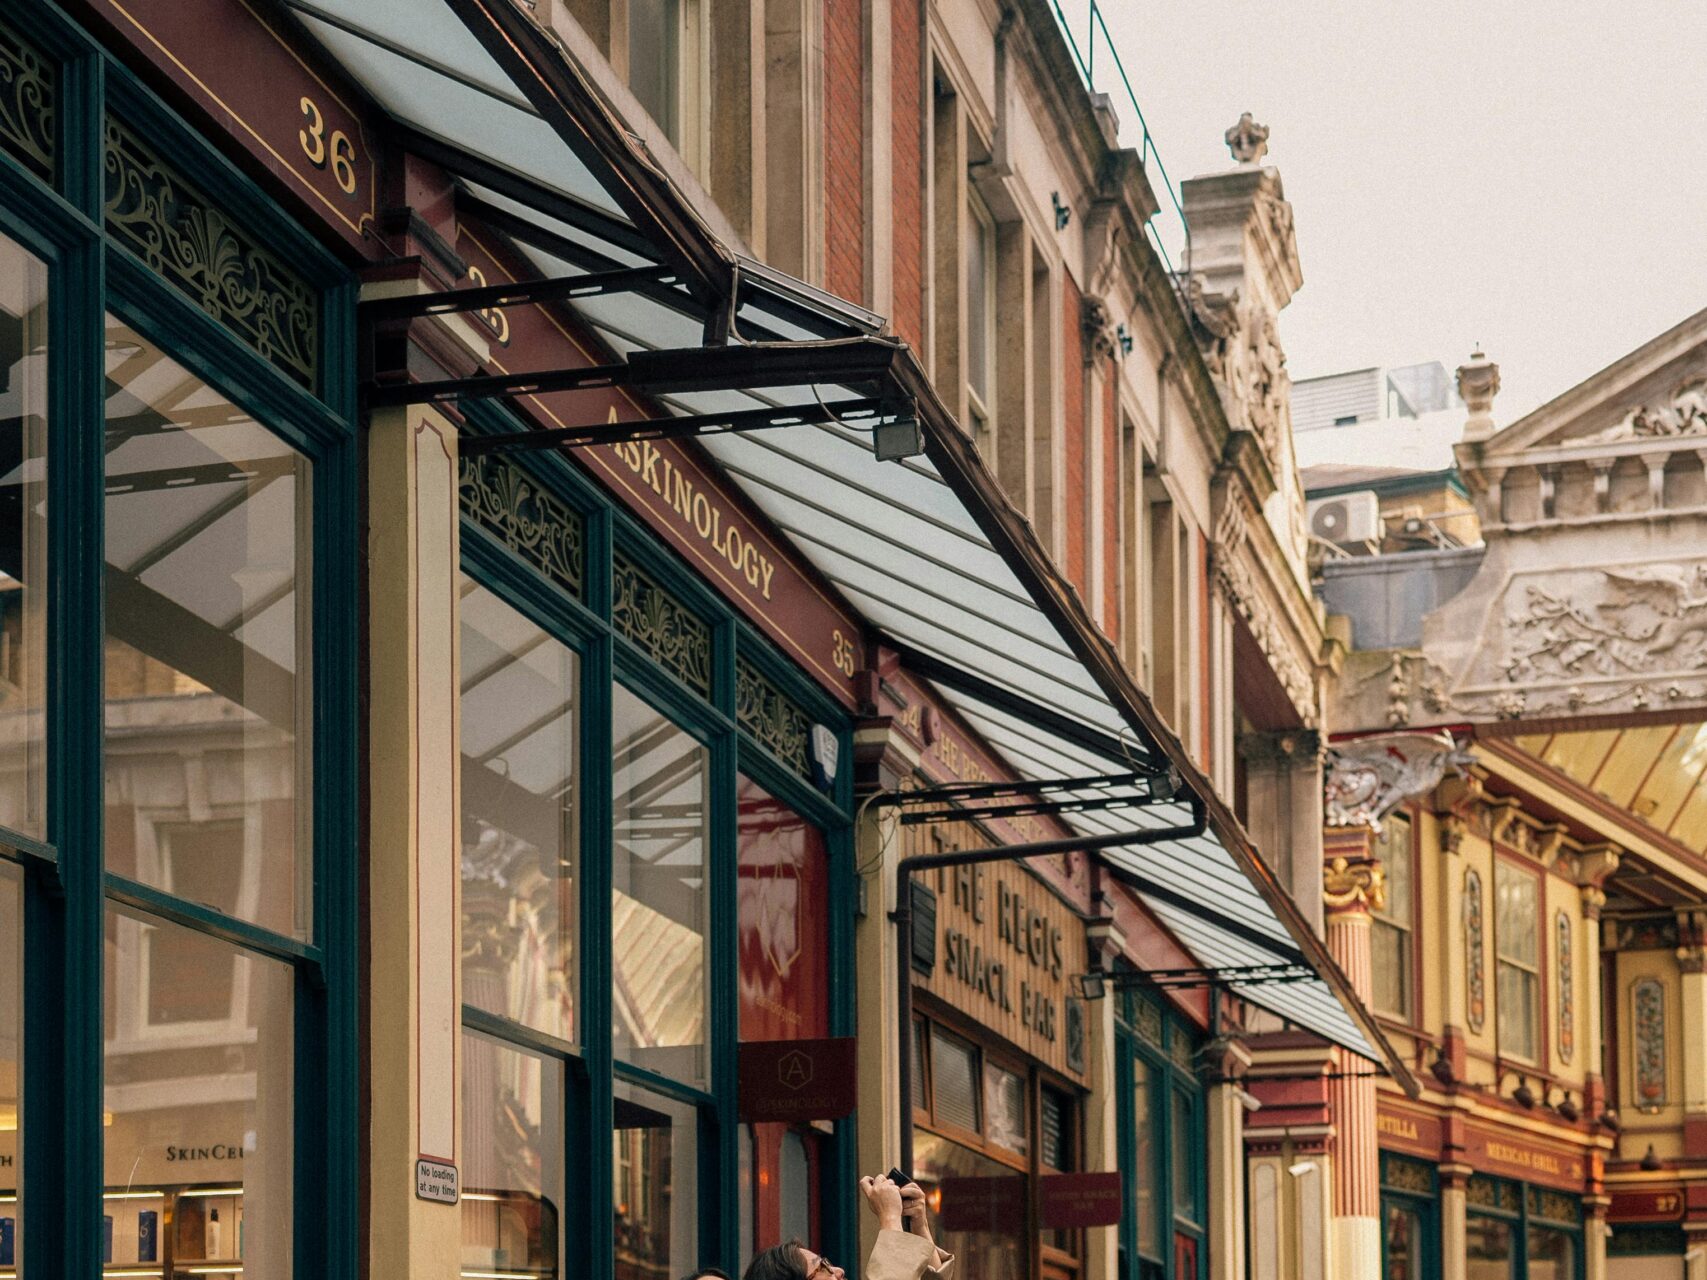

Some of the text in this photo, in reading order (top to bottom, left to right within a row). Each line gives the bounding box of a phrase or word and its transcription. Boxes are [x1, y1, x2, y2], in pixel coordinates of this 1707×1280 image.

[299, 96, 355, 194] 36
[832, 629, 854, 678] 35
[997, 879, 1063, 982] REGIS
[945, 927, 1056, 1042] SNACK BAR
[420, 1181, 455, 1197] at any time
[421, 1165, 454, 1183] No loading
